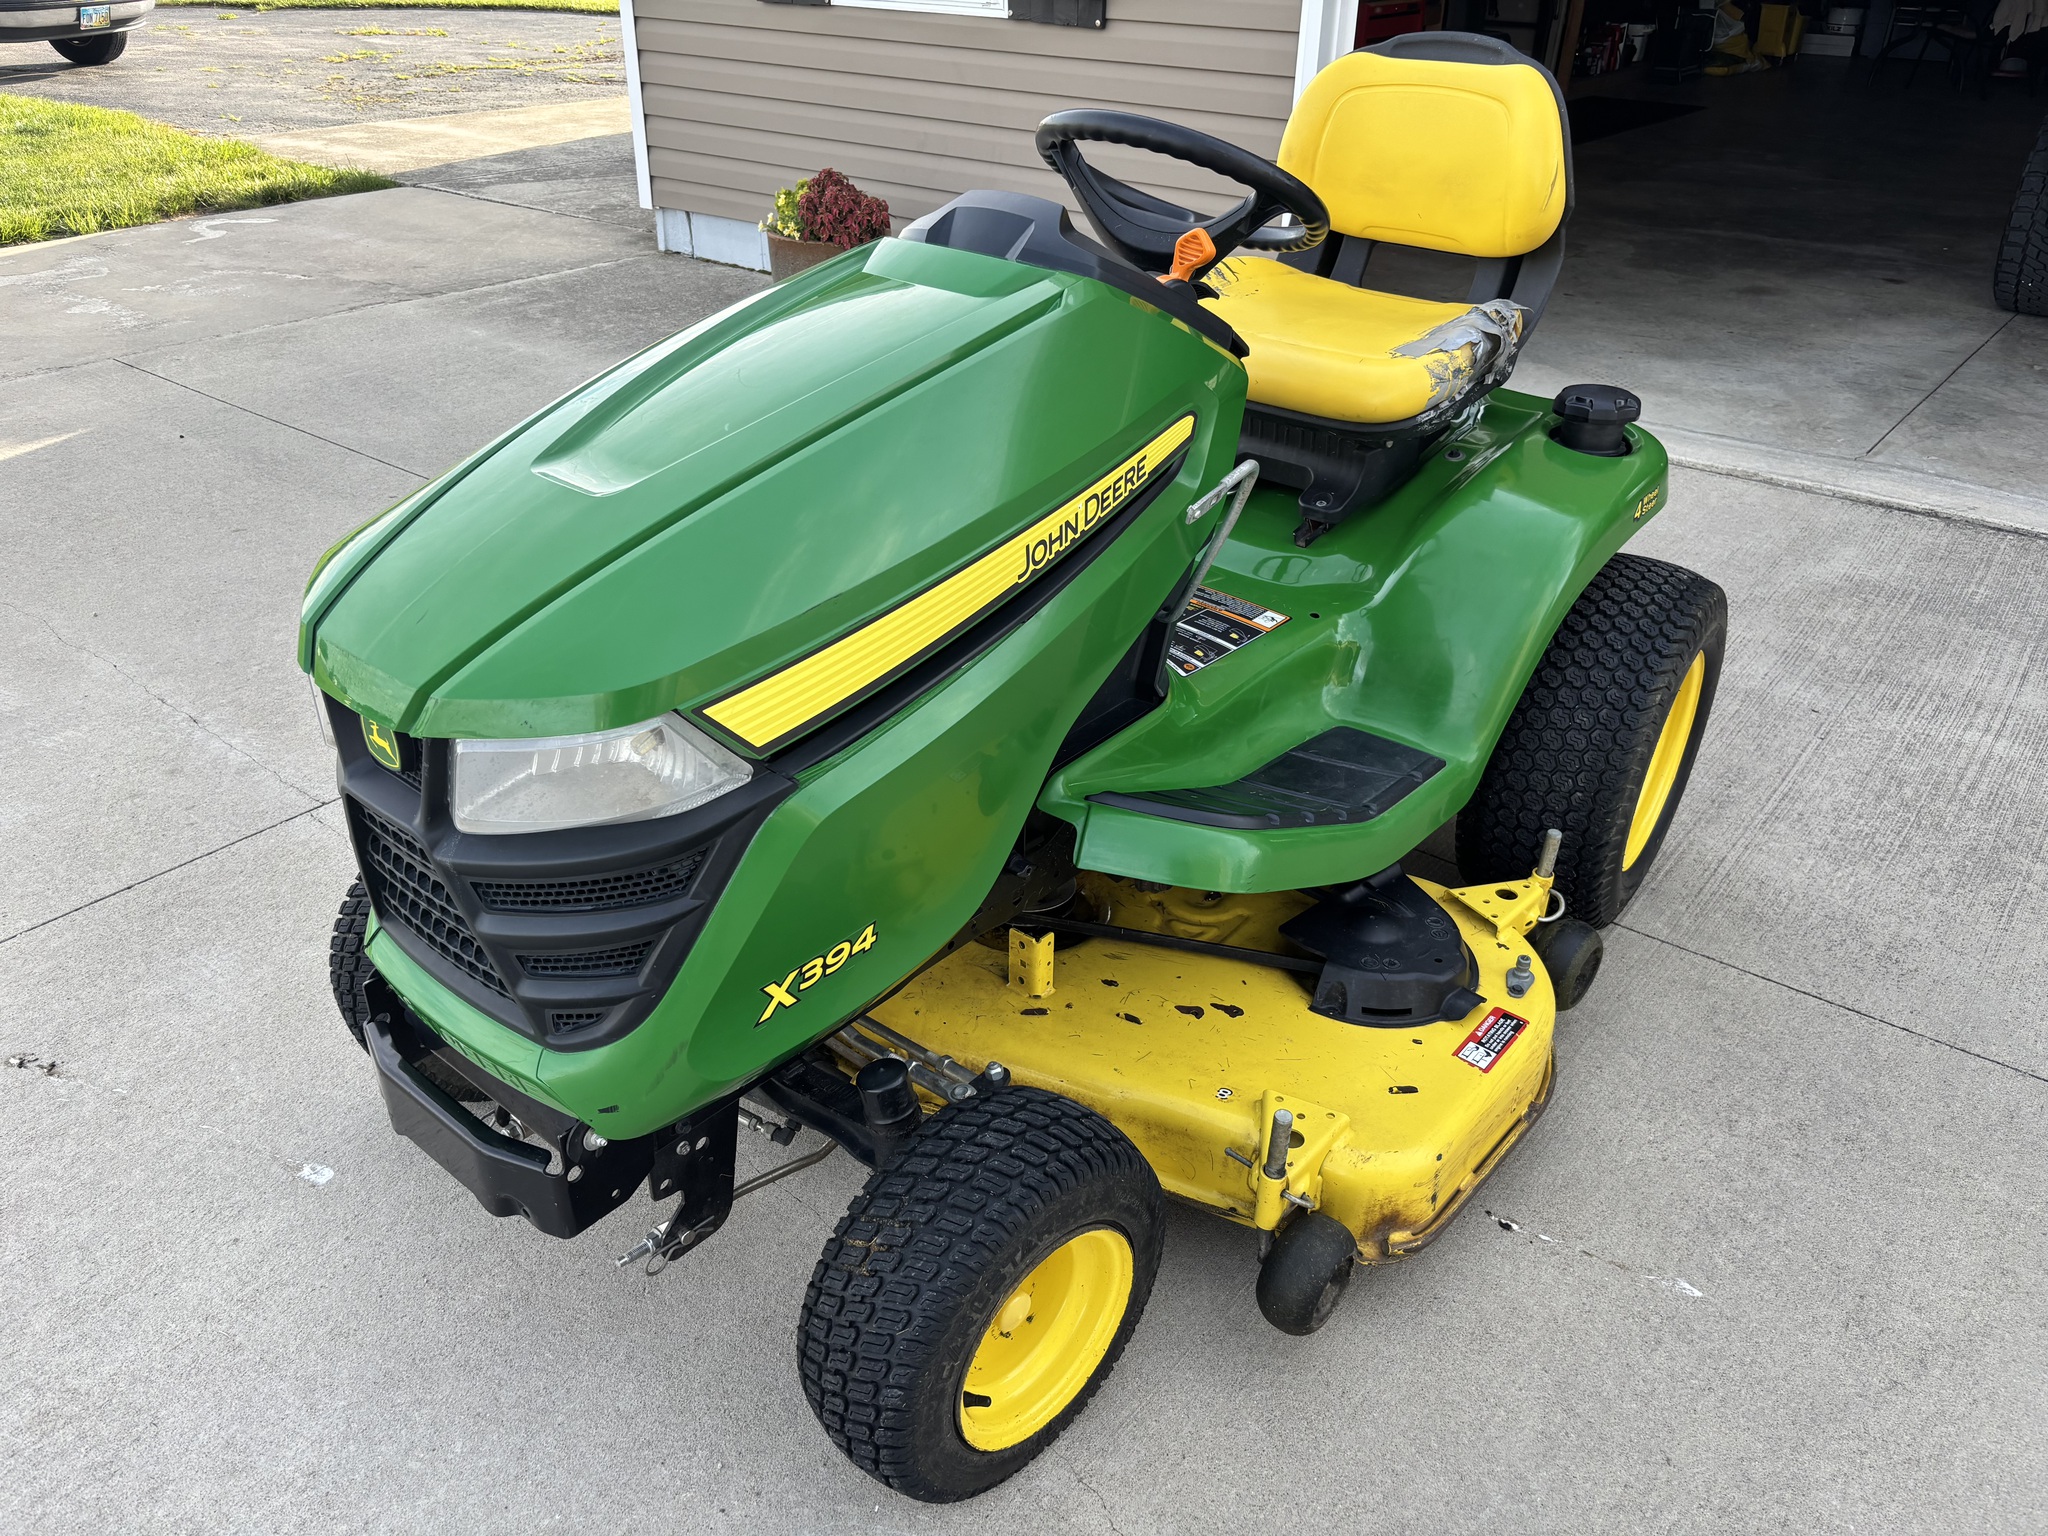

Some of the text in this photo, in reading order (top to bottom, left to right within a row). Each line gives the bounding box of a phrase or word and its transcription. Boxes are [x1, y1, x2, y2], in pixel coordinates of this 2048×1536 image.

[1018, 454, 1148, 580] JOHN DEERE
[1634, 500, 1643, 519] 4
[755, 921, 877, 1026] X394
[1478, 1015, 1496, 1032] DANGER
